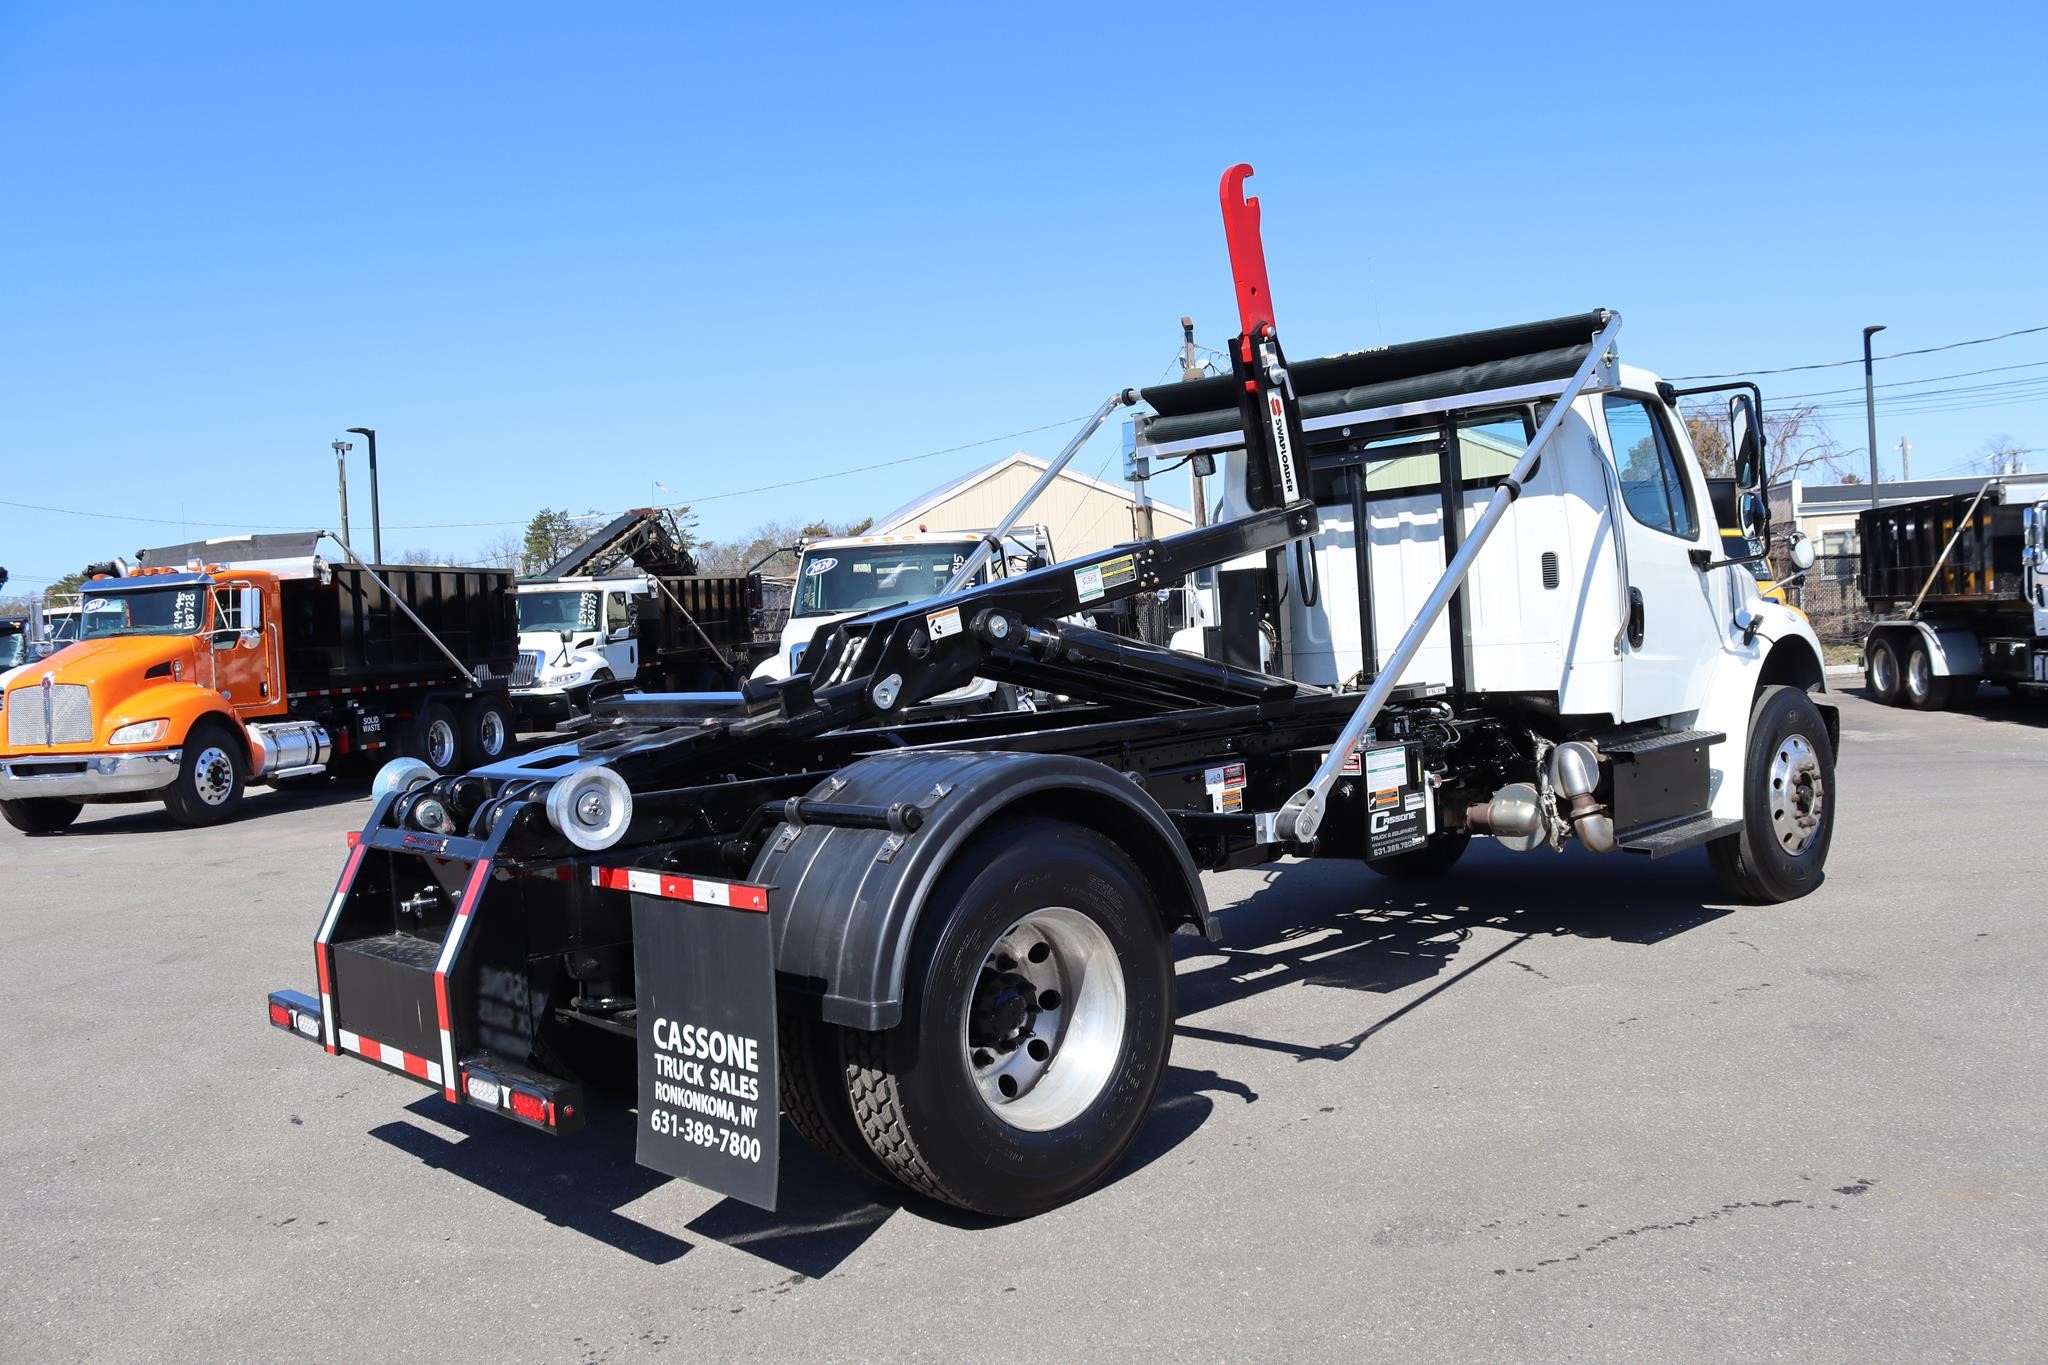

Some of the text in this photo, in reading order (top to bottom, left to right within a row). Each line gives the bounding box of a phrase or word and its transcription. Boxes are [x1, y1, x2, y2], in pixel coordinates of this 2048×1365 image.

[1275, 418, 1294, 493] SWAPLOADER
[811, 560, 832, 574] 2020
[183, 593, 196, 629] 188728
[587, 593, 598, 626] 563727
[362, 723, 381, 732] WASTE
[363, 716, 379, 725] SOLID
[1371, 833, 1387, 842] TRUCK
[653, 1018, 759, 1073] CASSONE
[654, 1053, 759, 1101] TRUCK SALES
[655, 1081, 758, 1128] RONKONKOMA, NY
[651, 1109, 761, 1163] 631-389-7800
